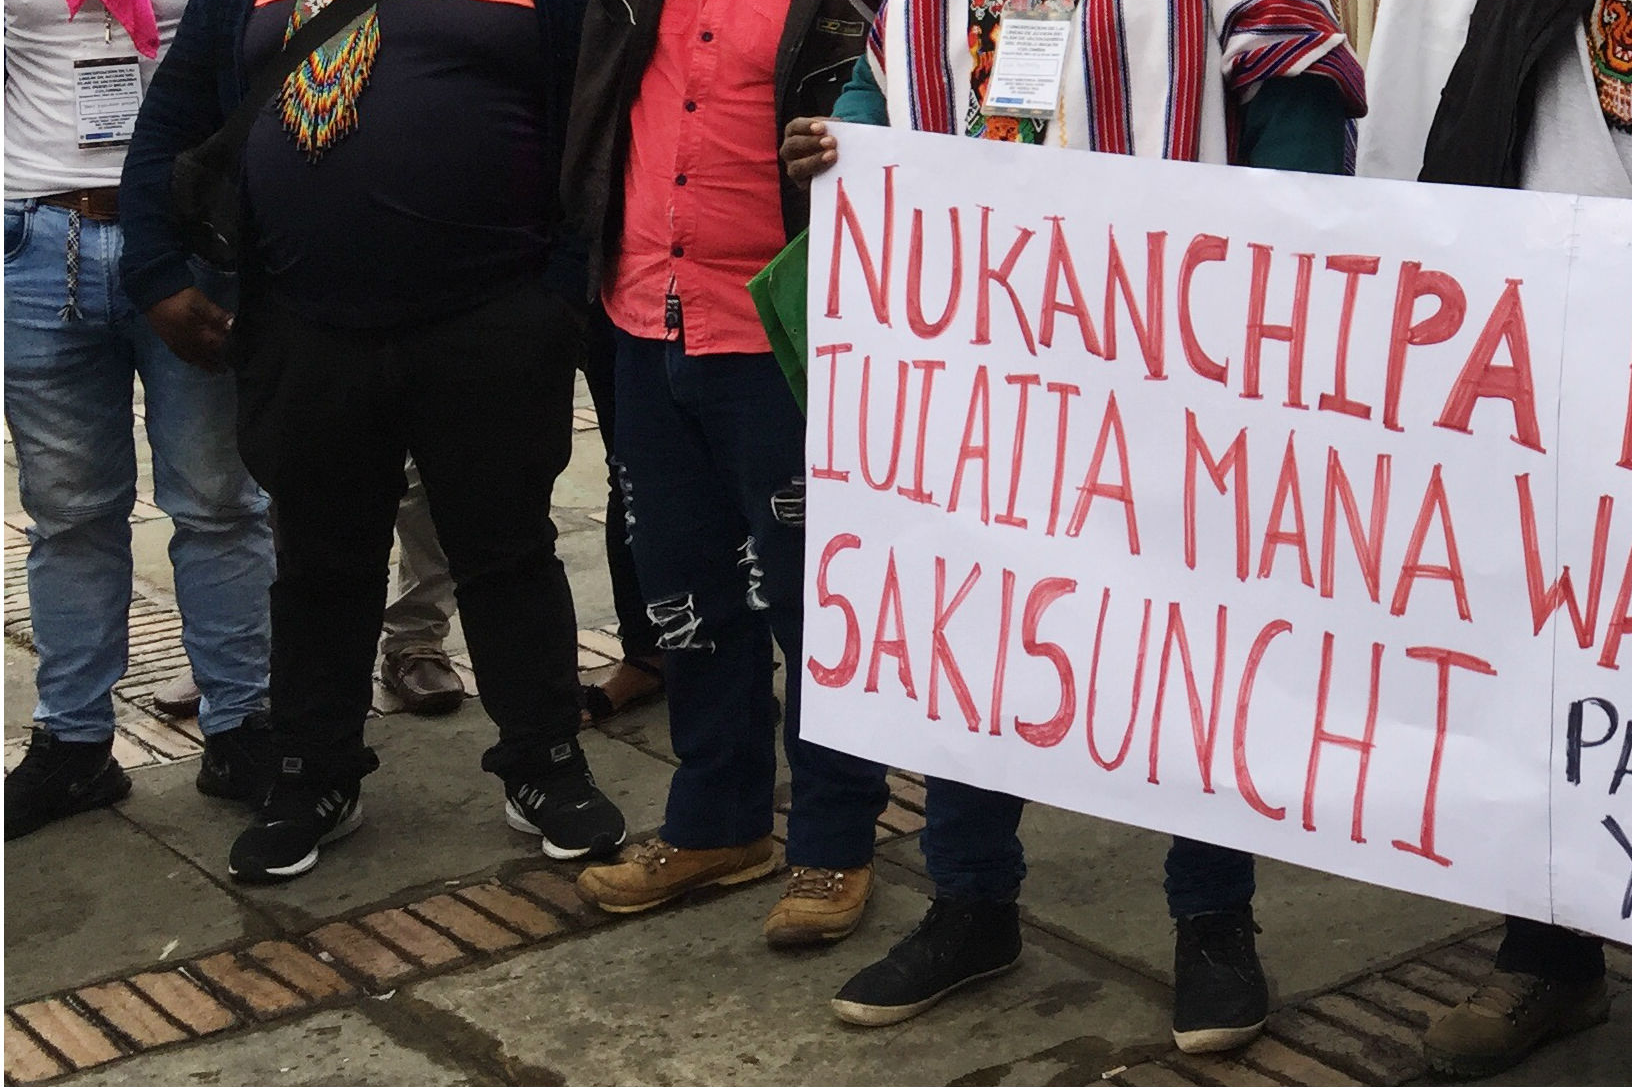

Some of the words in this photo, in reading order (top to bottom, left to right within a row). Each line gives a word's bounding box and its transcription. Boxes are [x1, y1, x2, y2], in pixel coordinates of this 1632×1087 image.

[825, 163, 1547, 454] NUKANCHIPA
[811, 342, 1141, 556] IUIAITA
[1184, 408, 1473, 623] MANA
[807, 532, 1498, 868] SAKISUNCHI
